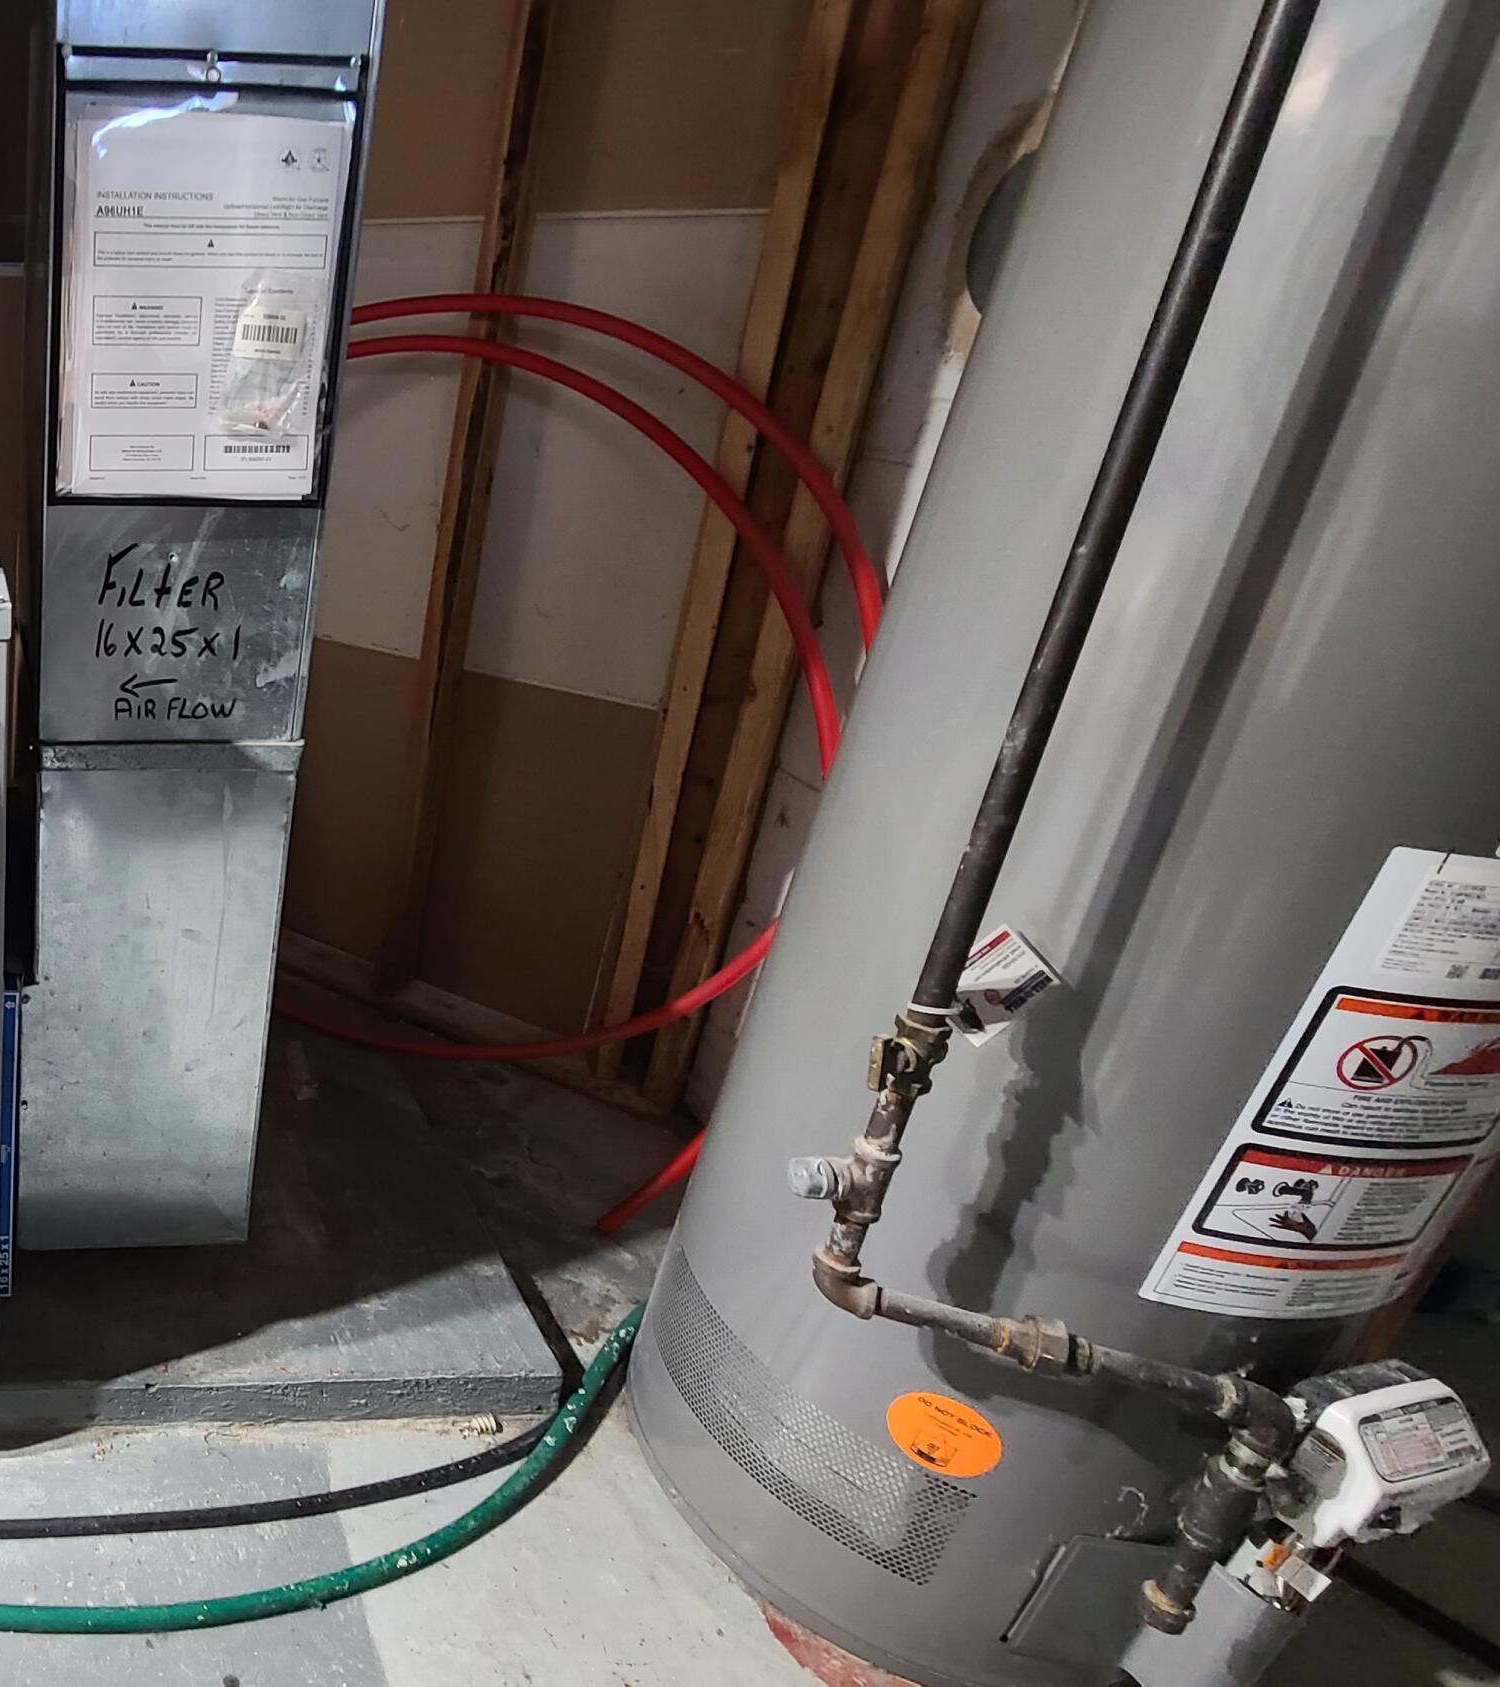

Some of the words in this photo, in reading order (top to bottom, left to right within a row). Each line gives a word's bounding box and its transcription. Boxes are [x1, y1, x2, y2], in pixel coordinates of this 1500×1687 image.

[96, 191, 152, 200] INSTALLATION
[153, 191, 214, 201] INSTRUCTIONS
[114, 697, 157, 720] AIR
[167, 697, 237, 720] FLOW
[1339, 1166, 1406, 1177] DANGER
[918, 1397, 932, 1407] DO
[934, 1406, 955, 1418] NOT
[957, 1418, 993, 1438] BLOCK
